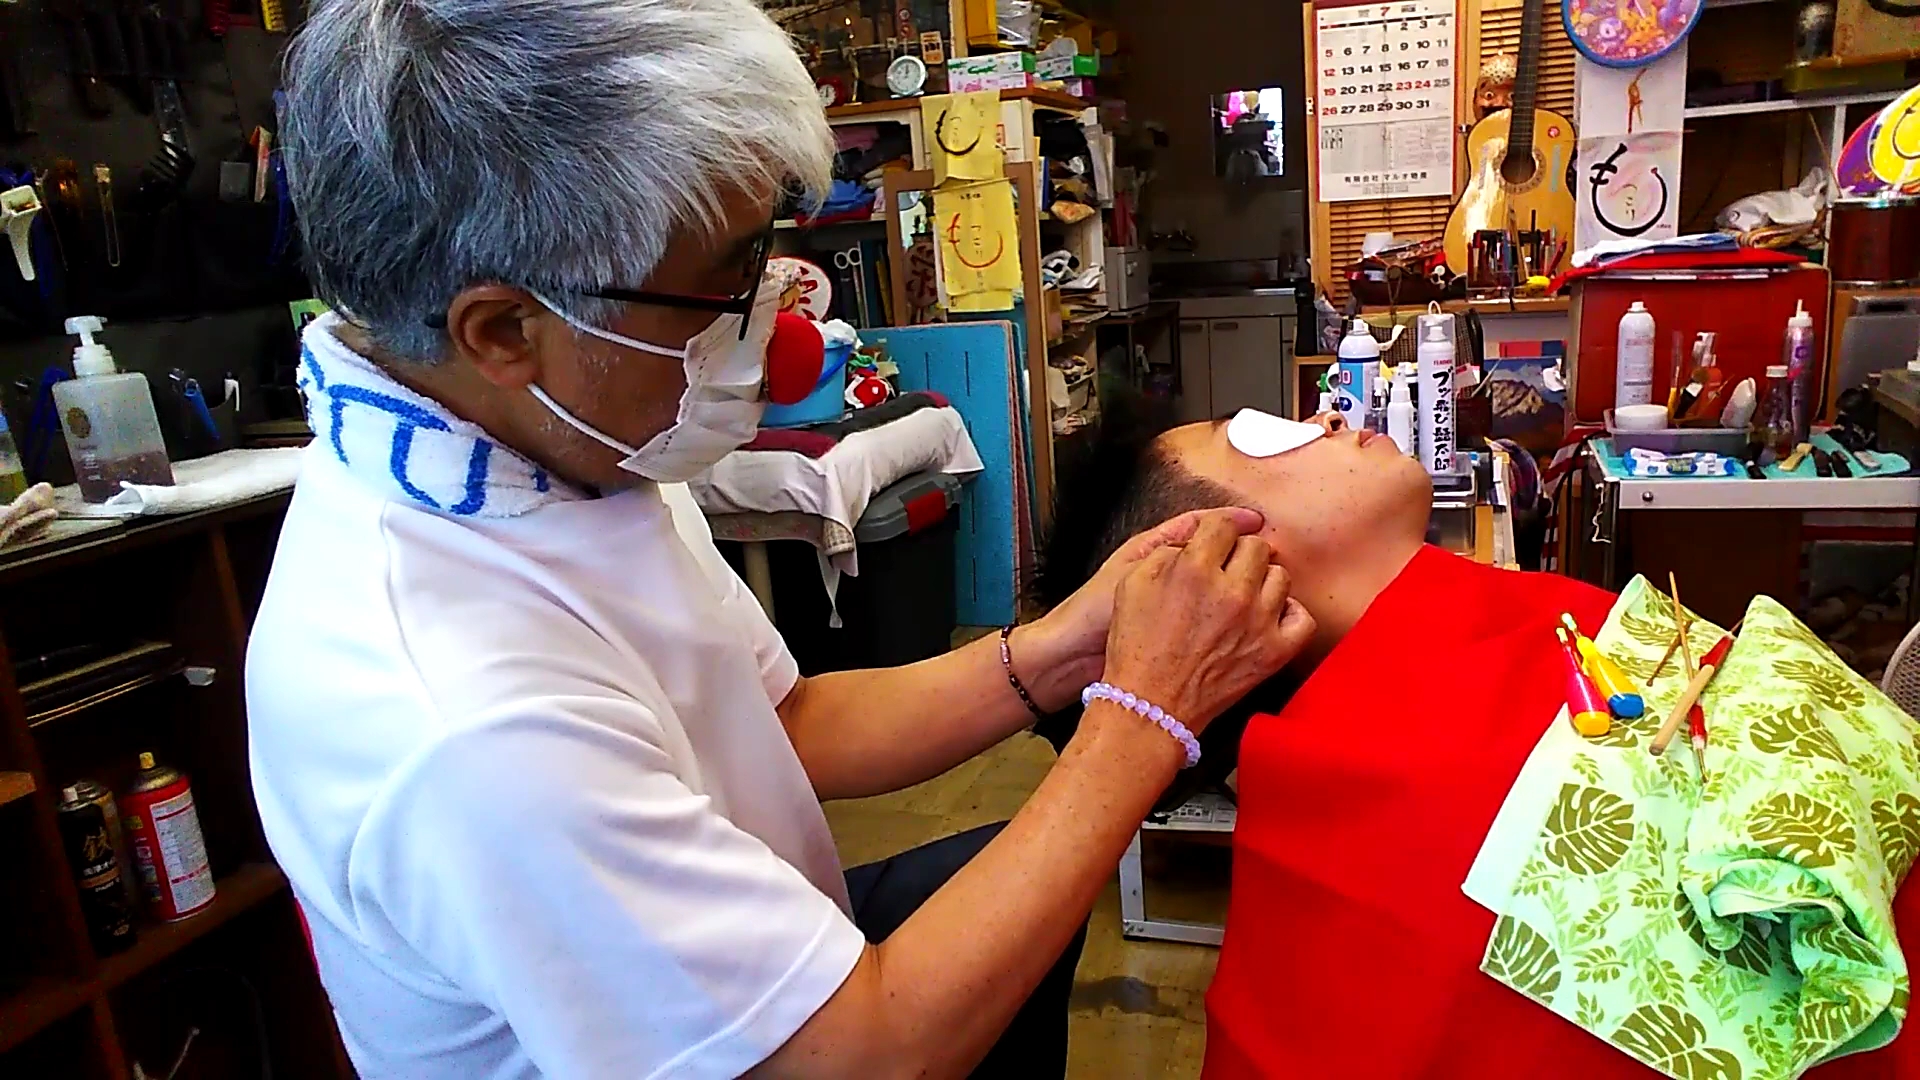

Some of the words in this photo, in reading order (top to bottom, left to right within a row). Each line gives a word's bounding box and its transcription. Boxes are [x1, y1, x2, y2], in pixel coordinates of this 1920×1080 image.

[1380, 7, 1390, 16] 7
[1400, 22, 1408, 31] 2
[1419, 20, 1427, 29] 3
[1438, 18, 1446, 26] 4
[1363, 46, 1370, 54] 7
[1382, 44, 1389, 52] 8
[1400, 43, 1408, 51] 9
[1437, 39, 1448, 47] 11
[1342, 67, 1354, 75] 13
[1379, 64, 1391, 72] 15
[1398, 62, 1410, 70] 16
[1417, 60, 1429, 68] 17
[1436, 59, 1448, 67] 18
[1324, 88, 1336, 96] 19
[1340, 86, 1356, 95] 20
[1361, 85, 1373, 93] 21
[1378, 83, 1392, 92] 22
[1396, 82, 1412, 90] 23
[1415, 81, 1430, 89] 24
[1434, 78, 1450, 87] 25
[1322, 107, 1338, 115] 26
[1341, 106, 1356, 114] 27
[1359, 104, 1374, 112] 28
[1377, 103, 1393, 111] 29
[1396, 101, 1412, 110] 30
[1416, 100, 1429, 108] 31
